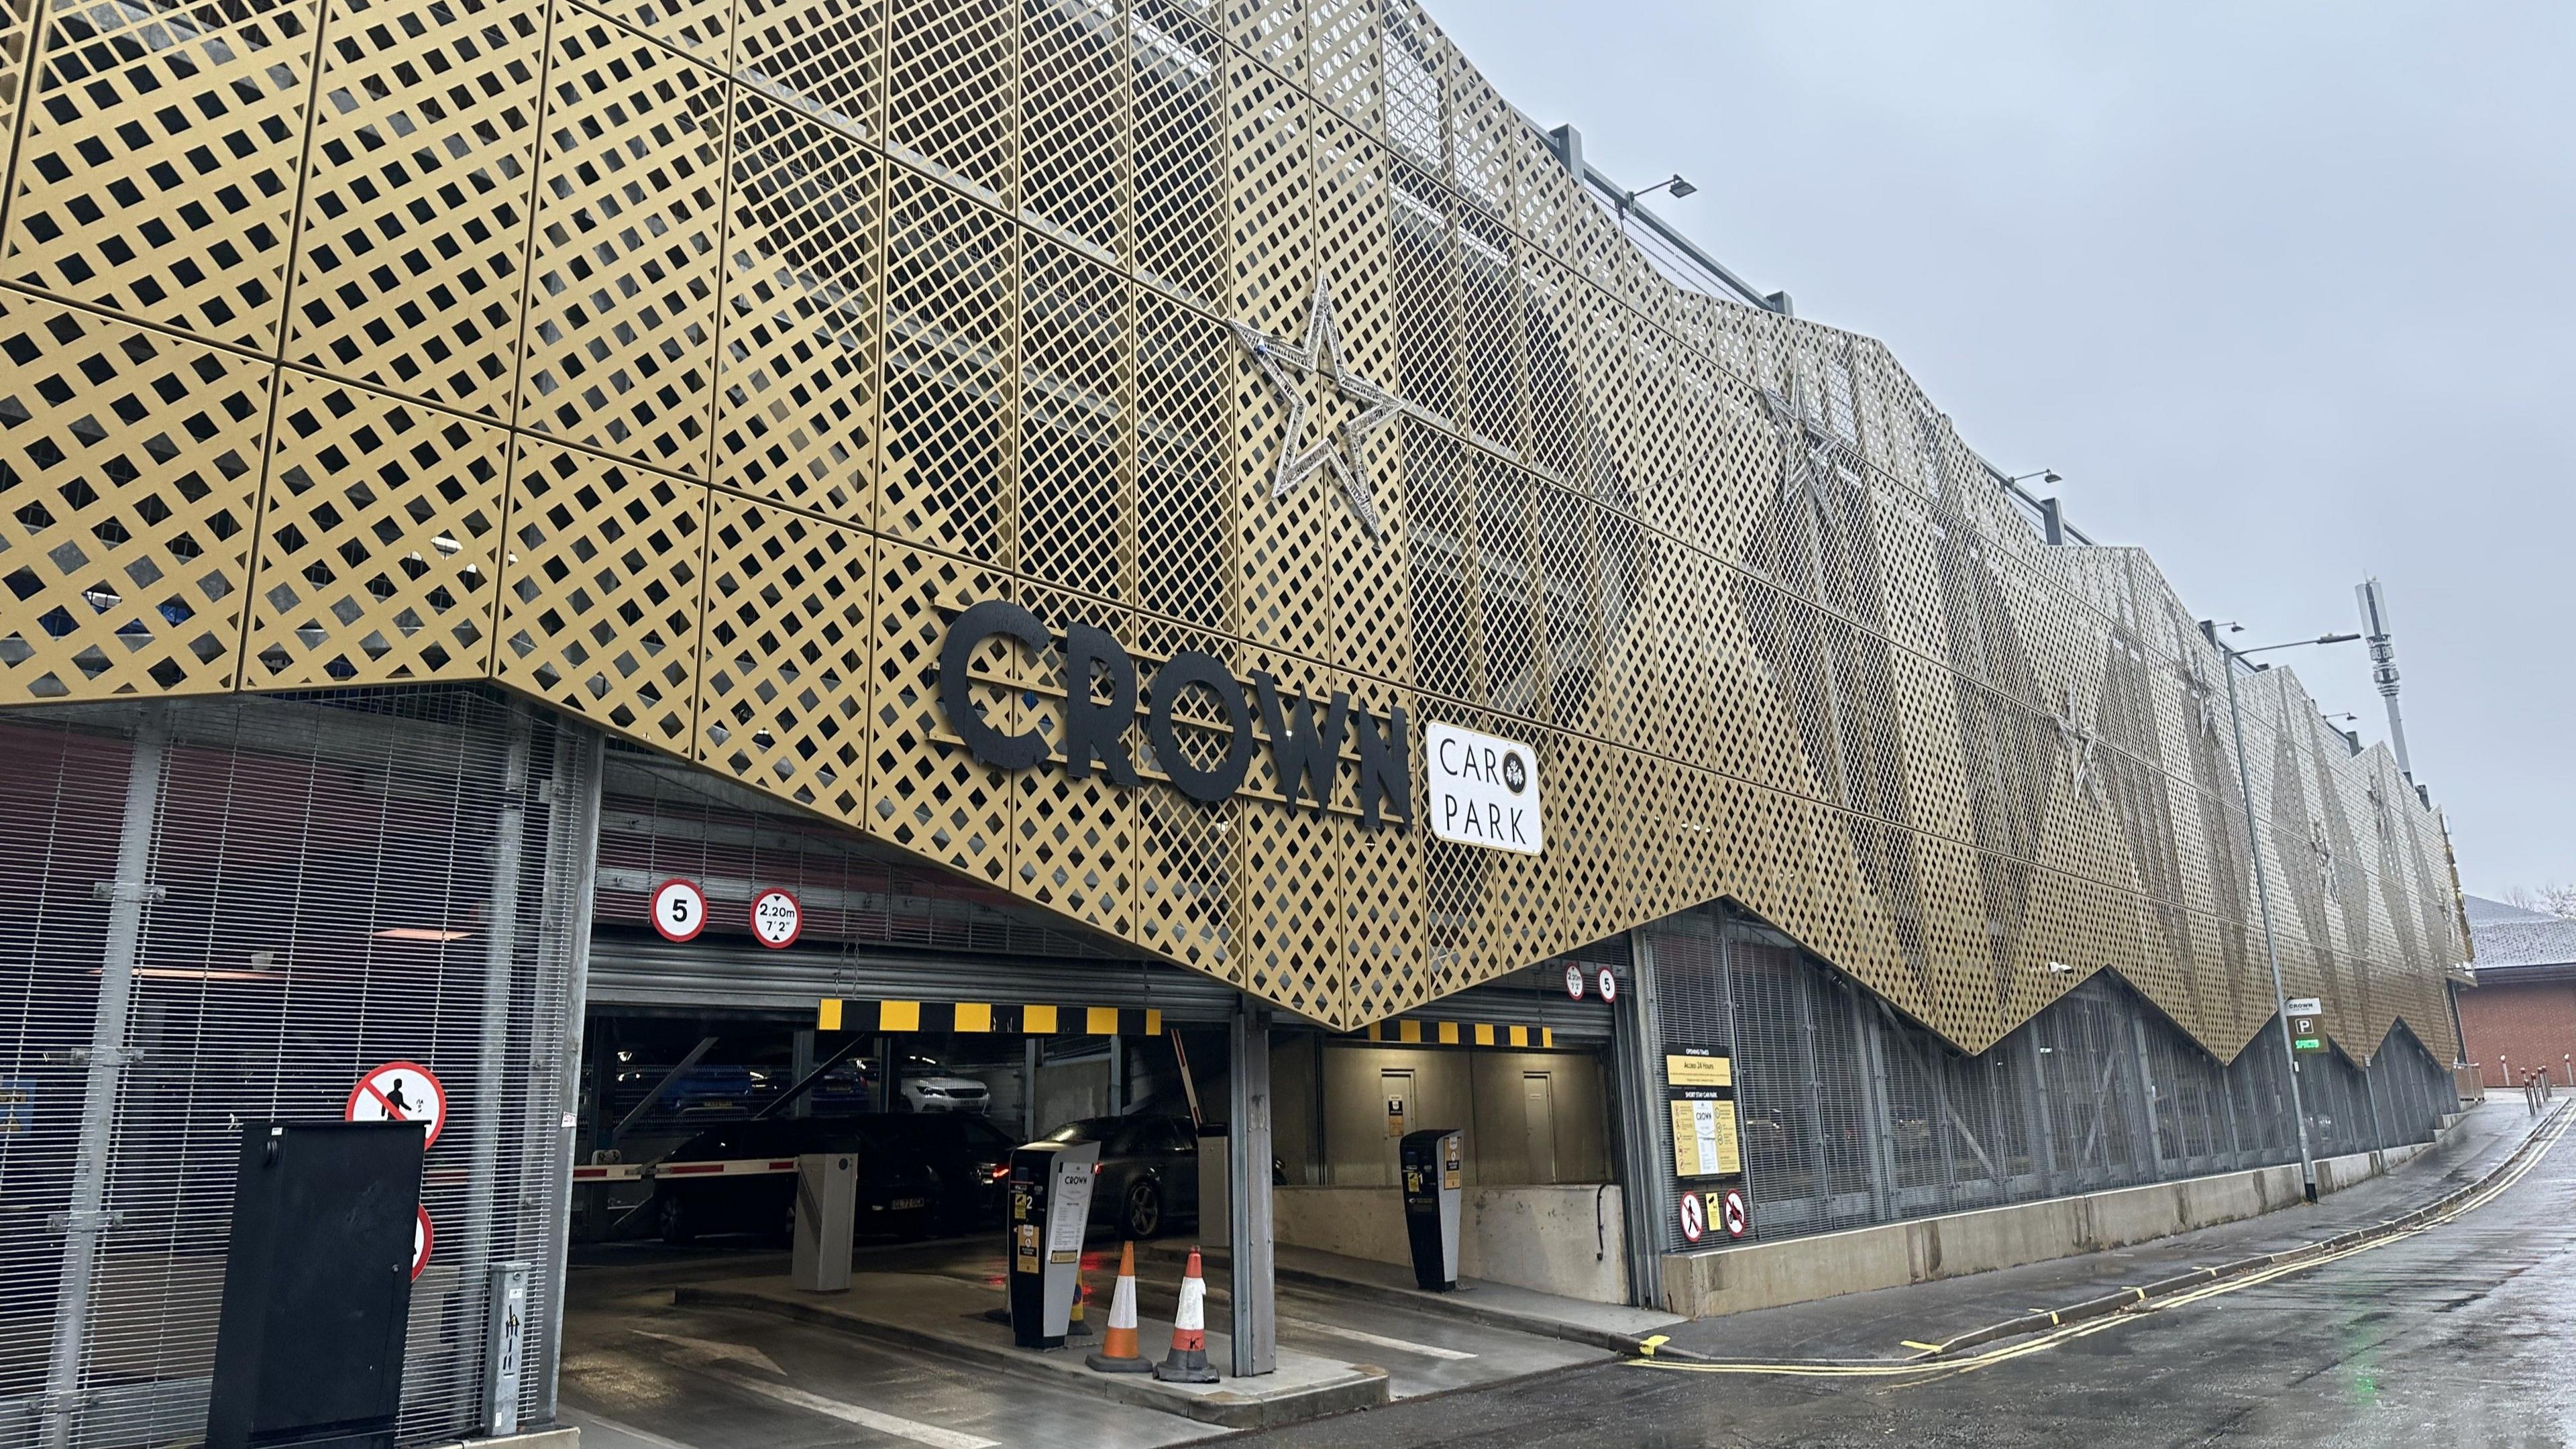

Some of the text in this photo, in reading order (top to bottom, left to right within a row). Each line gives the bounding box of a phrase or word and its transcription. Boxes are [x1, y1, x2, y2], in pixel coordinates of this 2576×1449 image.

[940, 600, 1413, 830] CROWN
[1440, 738, 1500, 786] CAR
[1445, 794, 1526, 845] PARK
[672, 899, 688, 922] 5
[759, 904, 795, 918] 2.20m
[1604, 977, 1610, 991] 5
[2299, 1020, 2310, 1032] P
[1065, 1175, 1087, 1185] CROWN
[1026, 1195, 1033, 1210] 2
